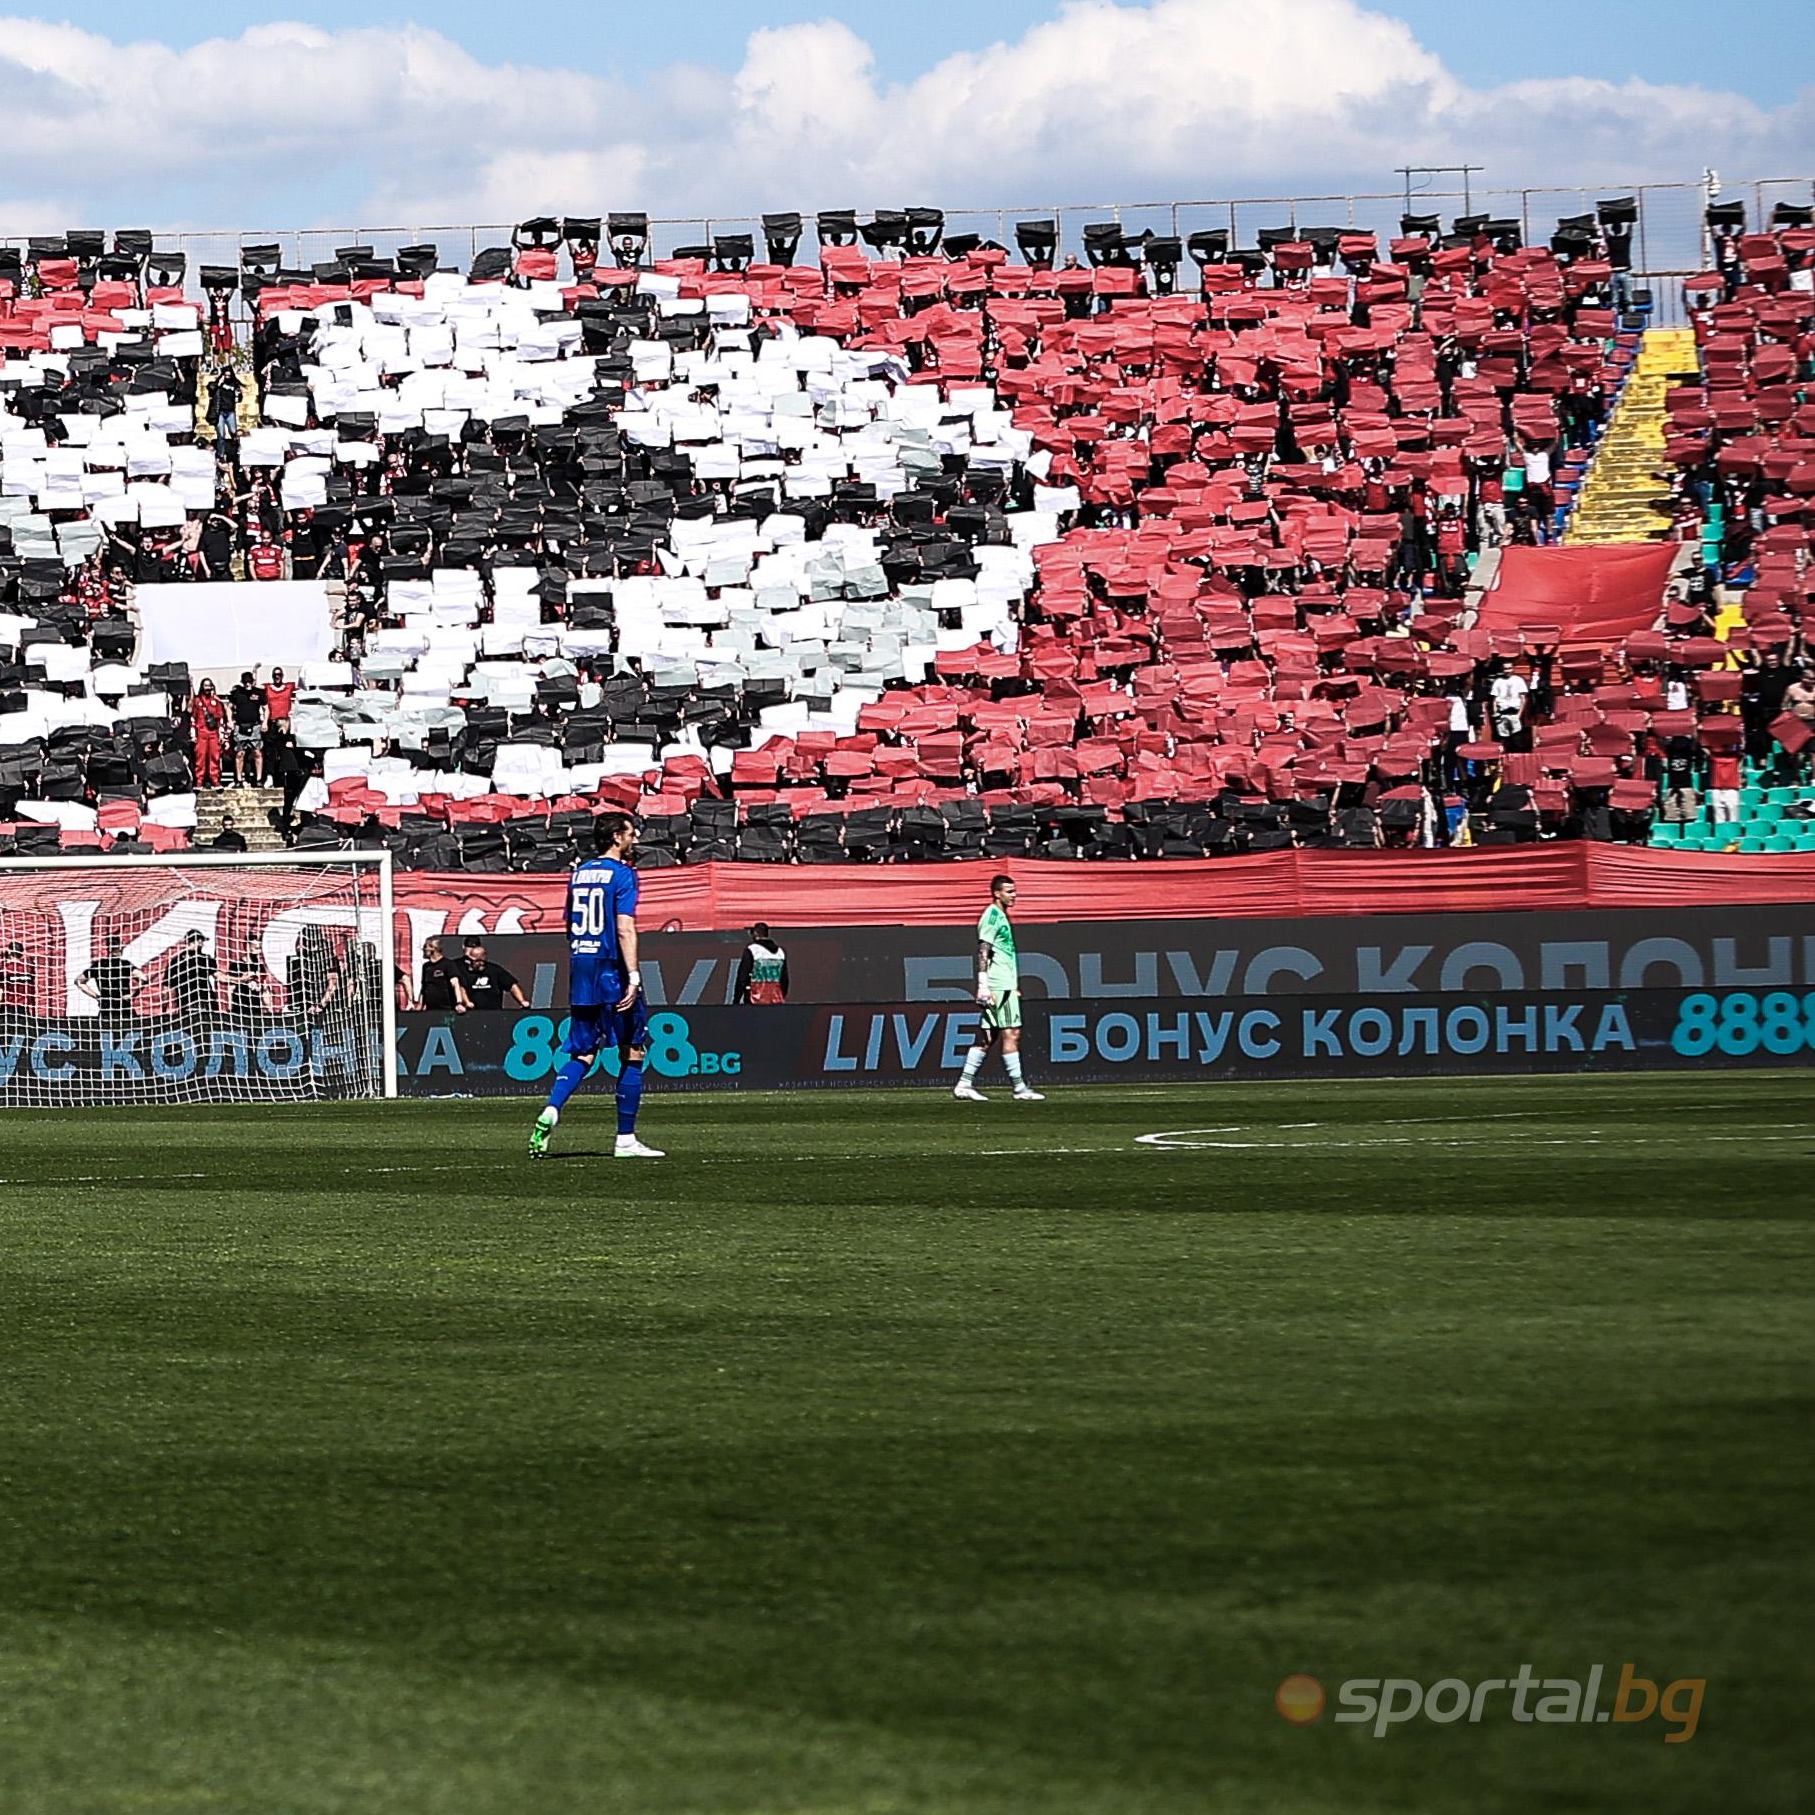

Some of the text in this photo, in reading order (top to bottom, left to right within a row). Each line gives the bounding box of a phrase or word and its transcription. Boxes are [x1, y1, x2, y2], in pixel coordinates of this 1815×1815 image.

[570, 887, 604, 936] 50
[823, 1012, 982, 1070] LIVE
[1049, 991, 1815, 1064] БОНУС КОЛОНКА 888
